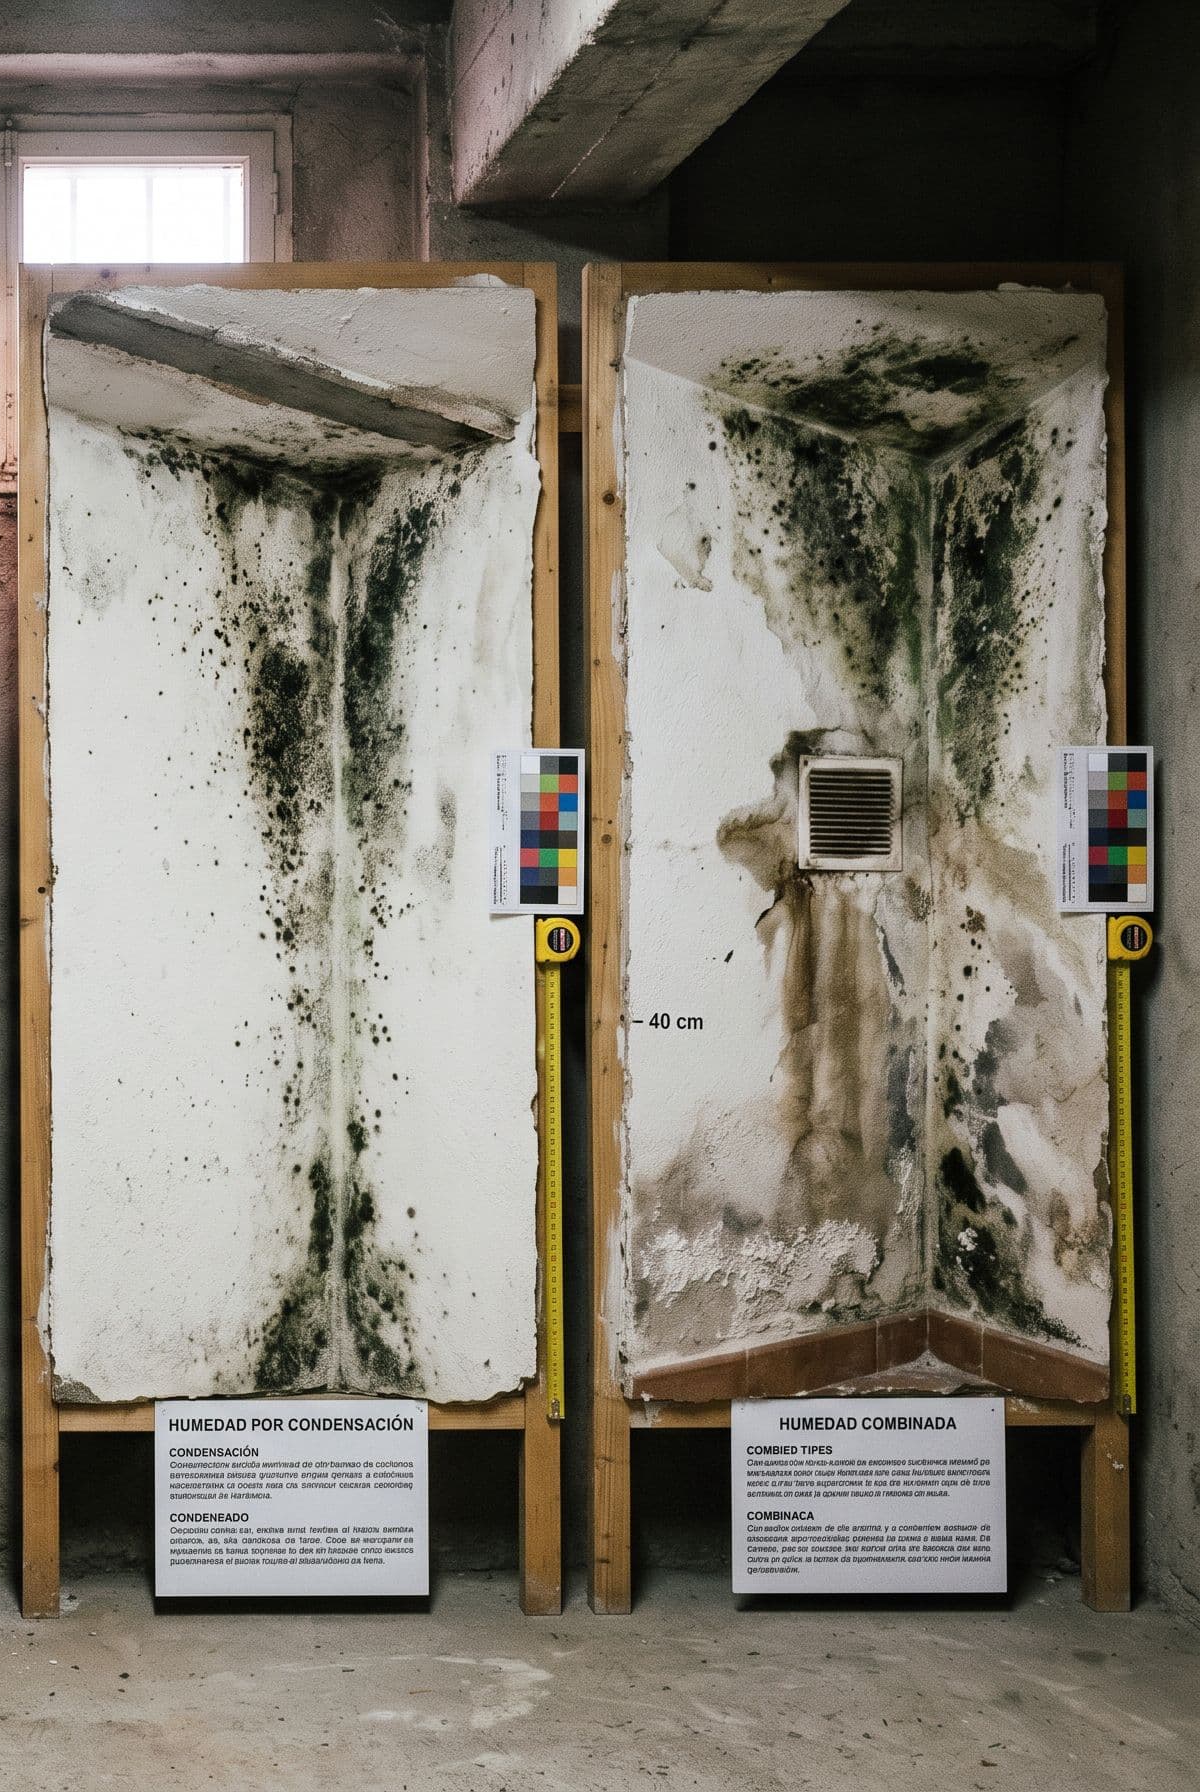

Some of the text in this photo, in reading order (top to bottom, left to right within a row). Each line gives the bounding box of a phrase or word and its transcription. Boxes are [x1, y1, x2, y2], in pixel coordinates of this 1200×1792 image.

[649, 1012, 703, 1030] 40 cm
[169, 1414, 414, 1432] HUMEDAD POR CONDENSACIÓN
[779, 1416, 957, 1431] HUMEDAD COMBINADA
[169, 1445, 259, 1457] CONDENSACIÓN
[746, 1445, 833, 1455] COMBIED TIPES
[169, 1512, 249, 1523] CONDENEADO
[746, 1511, 815, 1521] COMBINACA
